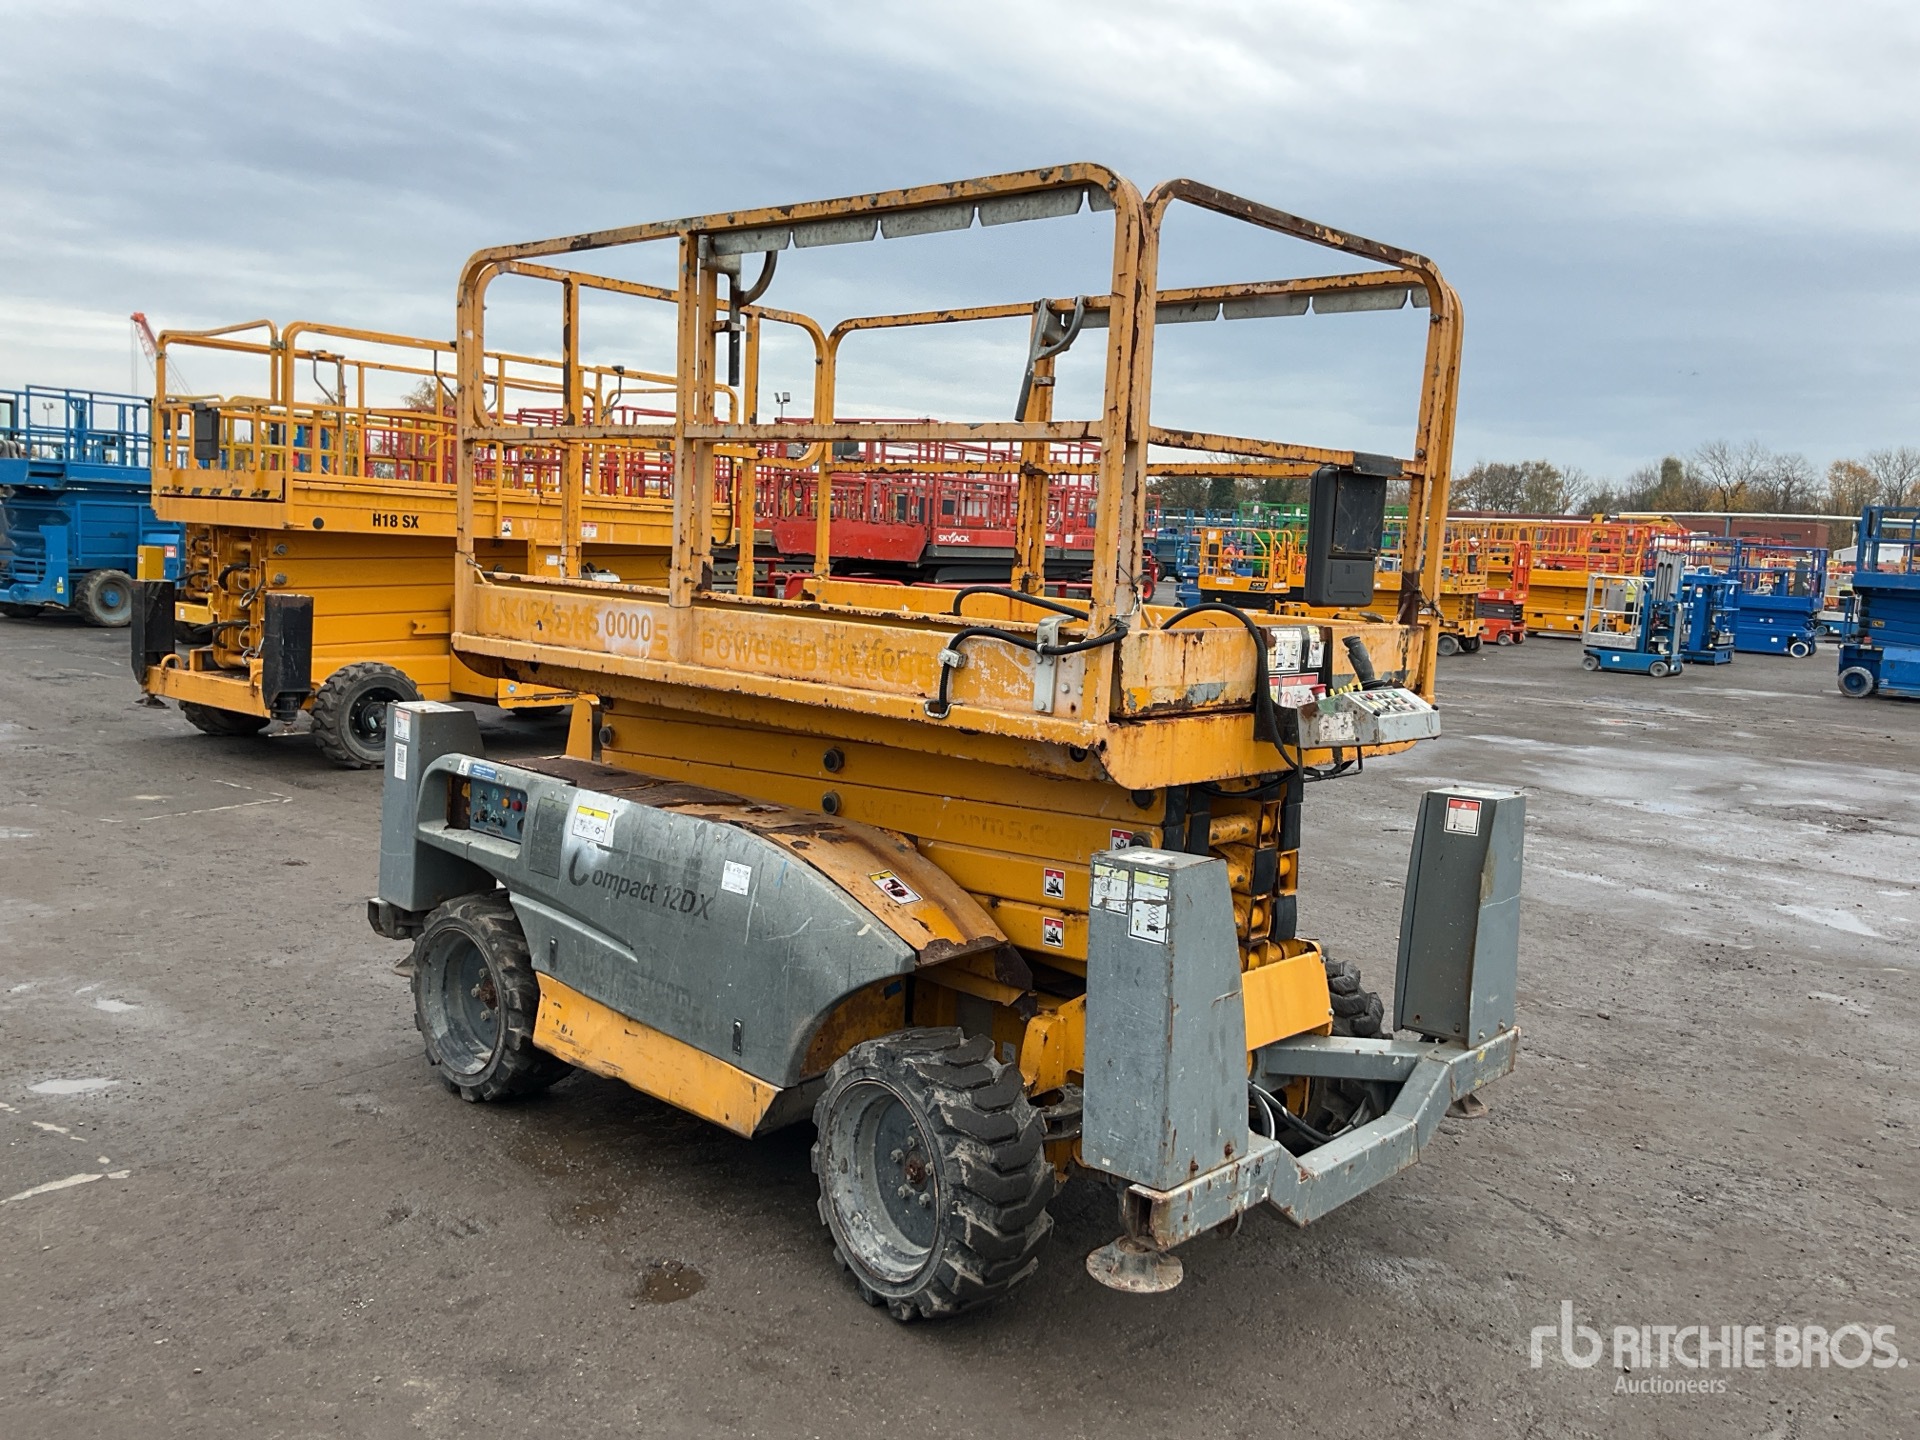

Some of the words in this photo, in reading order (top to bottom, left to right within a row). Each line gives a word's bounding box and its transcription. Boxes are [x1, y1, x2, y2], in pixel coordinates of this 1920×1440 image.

[372, 513, 398, 528] H18
[402, 514, 419, 529] SX
[938, 532, 970, 544] SKYJACK
[605, 610, 651, 642] 0000
[568, 848, 658, 903] Compact
